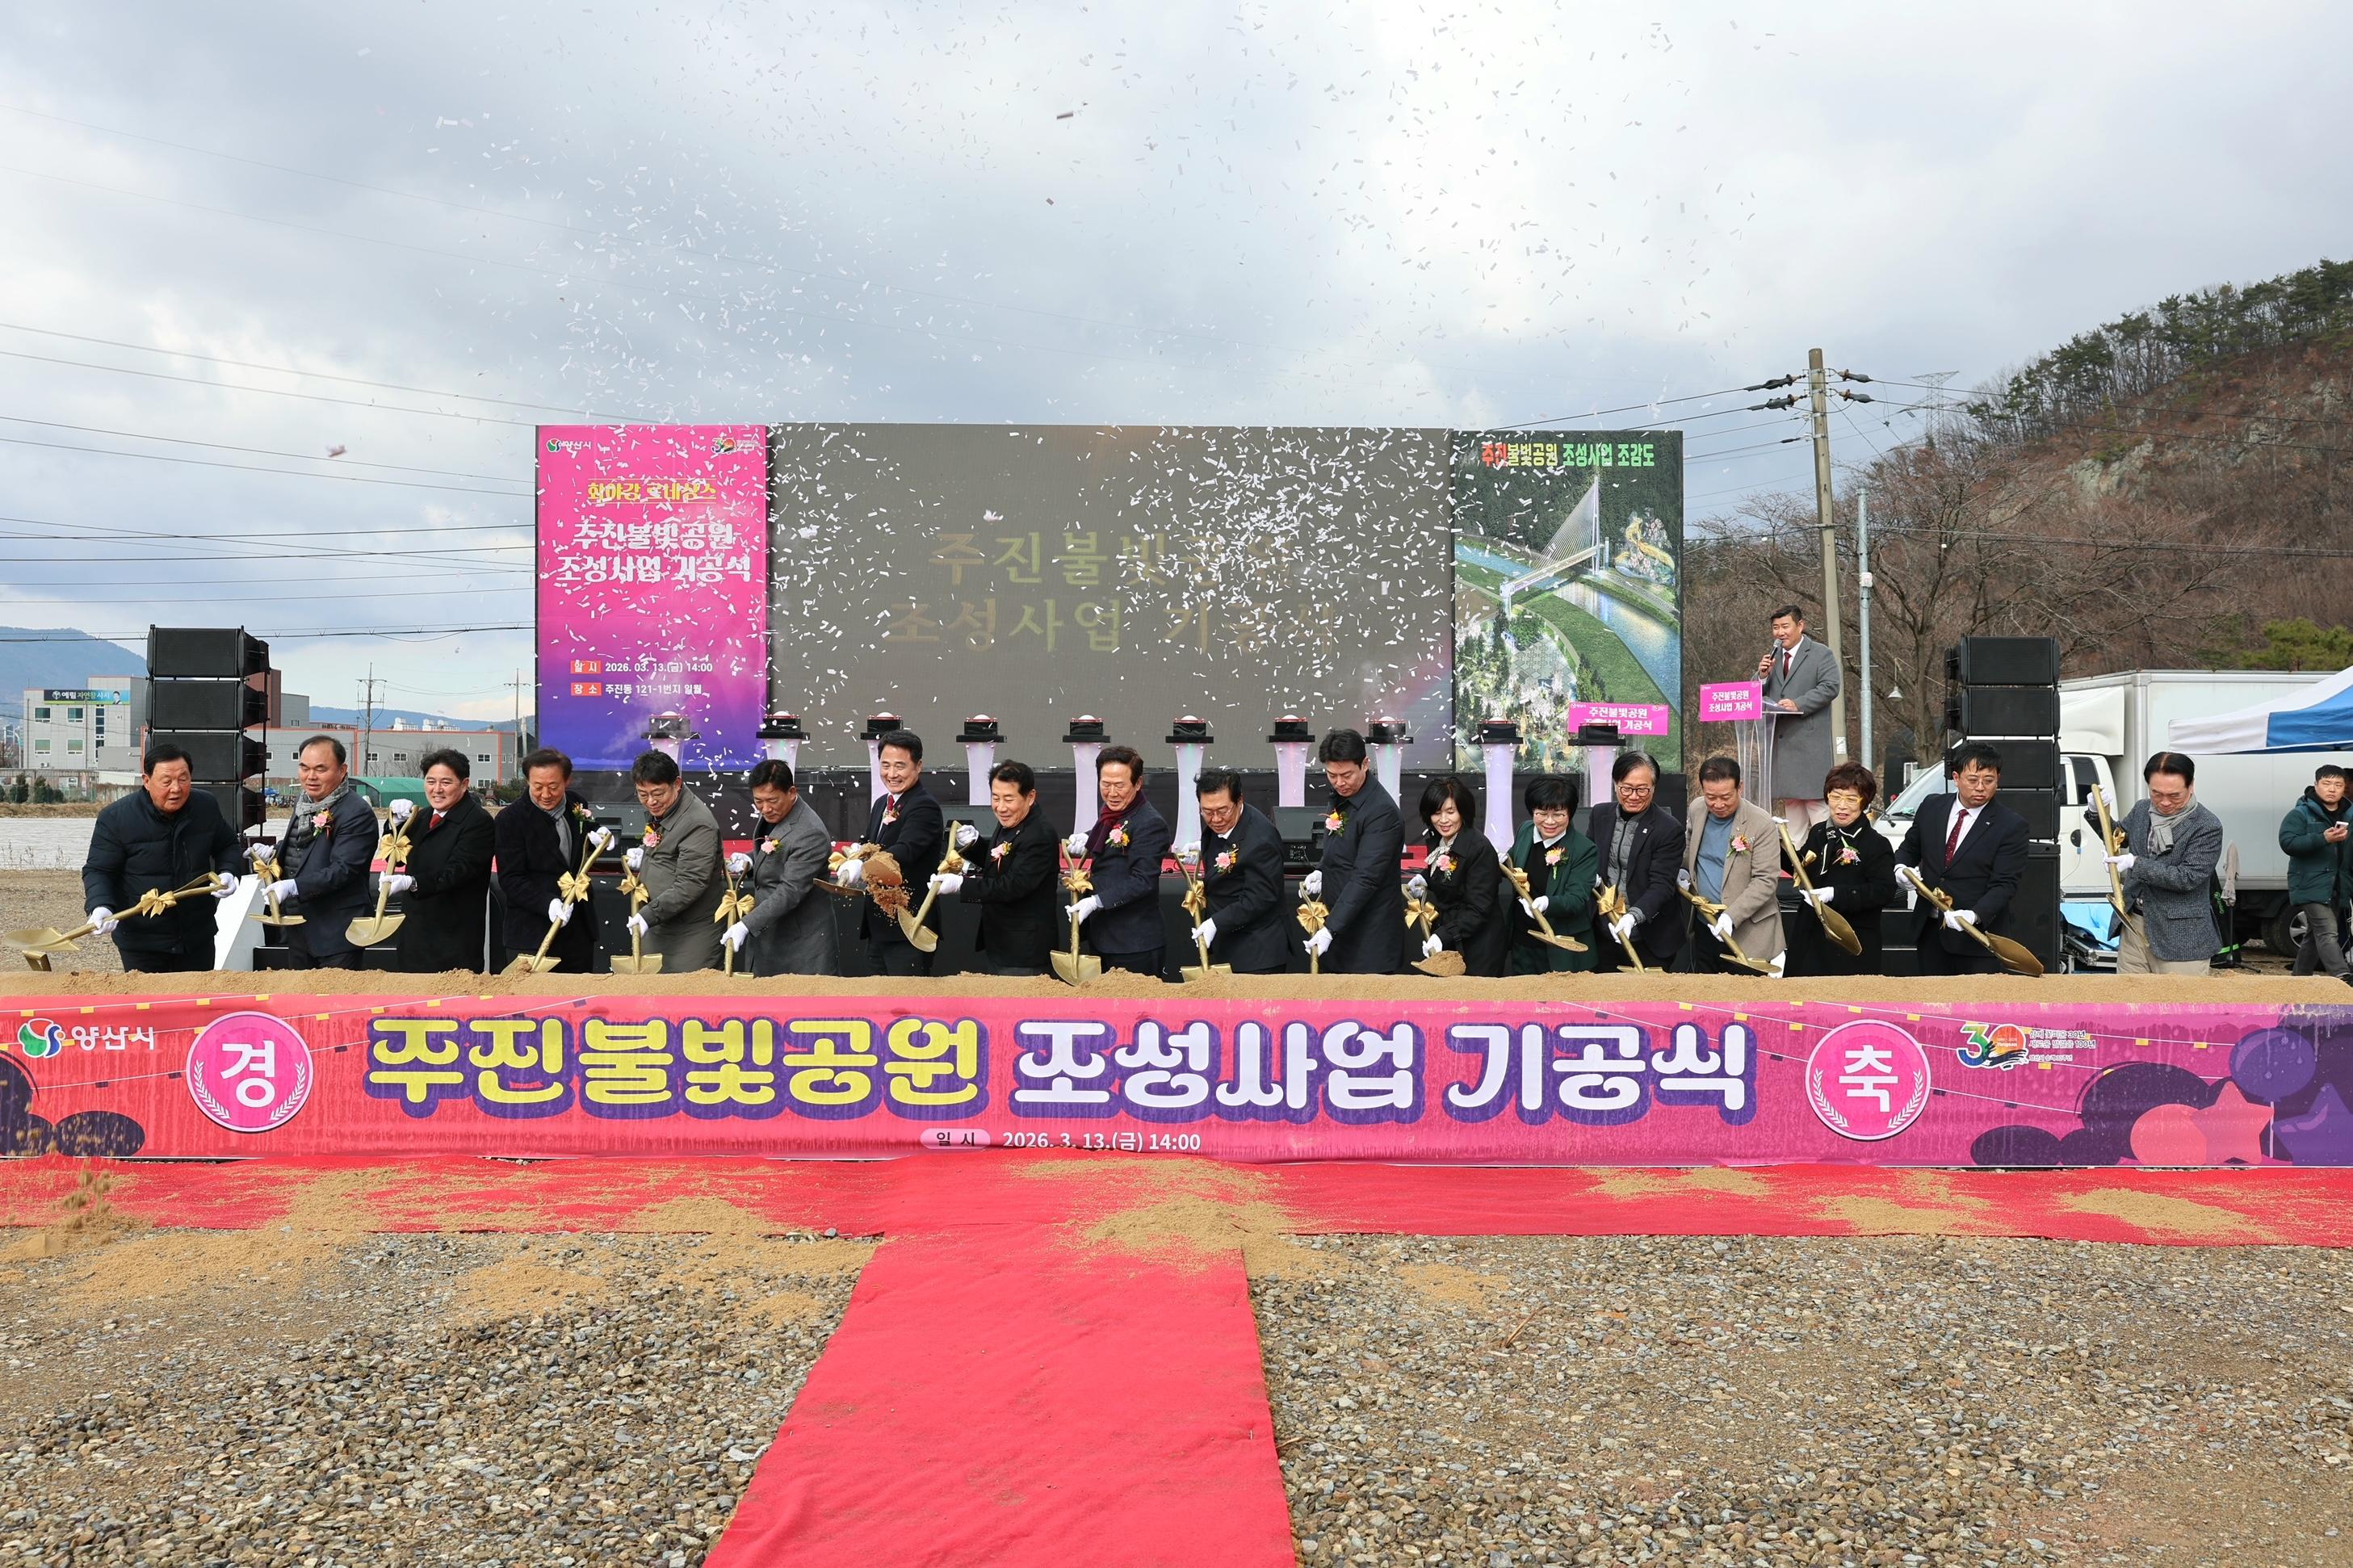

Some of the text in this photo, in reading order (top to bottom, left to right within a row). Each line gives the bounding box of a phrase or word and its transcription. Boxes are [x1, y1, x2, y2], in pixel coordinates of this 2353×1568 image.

[1482, 442, 1655, 467] 주진불빛공원 조성사업 조감도
[573, 522, 734, 550] 주진불빛공원
[556, 555, 751, 583] 조성사업 기공식
[884, 597, 1121, 652] 조성사업
[606, 662, 713, 673] 2026. 03. 13.(금) 14:00
[606, 684, 632, 694] 주진동
[635, 685, 681, 694] 121-1번지
[1712, 690, 1749, 701] 주진불빛공원
[1588, 706, 1647, 719] 주진불빛공원
[1709, 702, 1752, 712] 조성사업 기공식
[1623, 719, 1652, 731] 기공식
[71, 1026, 154, 1050] 양산시
[2068, 1029, 2086, 1039] 30년
[2075, 1040, 2096, 1049] 100년
[220, 1039, 276, 1108] 경
[370, 1018, 1746, 1110] 주진불빛공원 조성사업 기공식
[1839, 1044, 1899, 1113] 축
[1003, 1132, 1201, 1152] 2026. 3. 13.(금) 14:00
